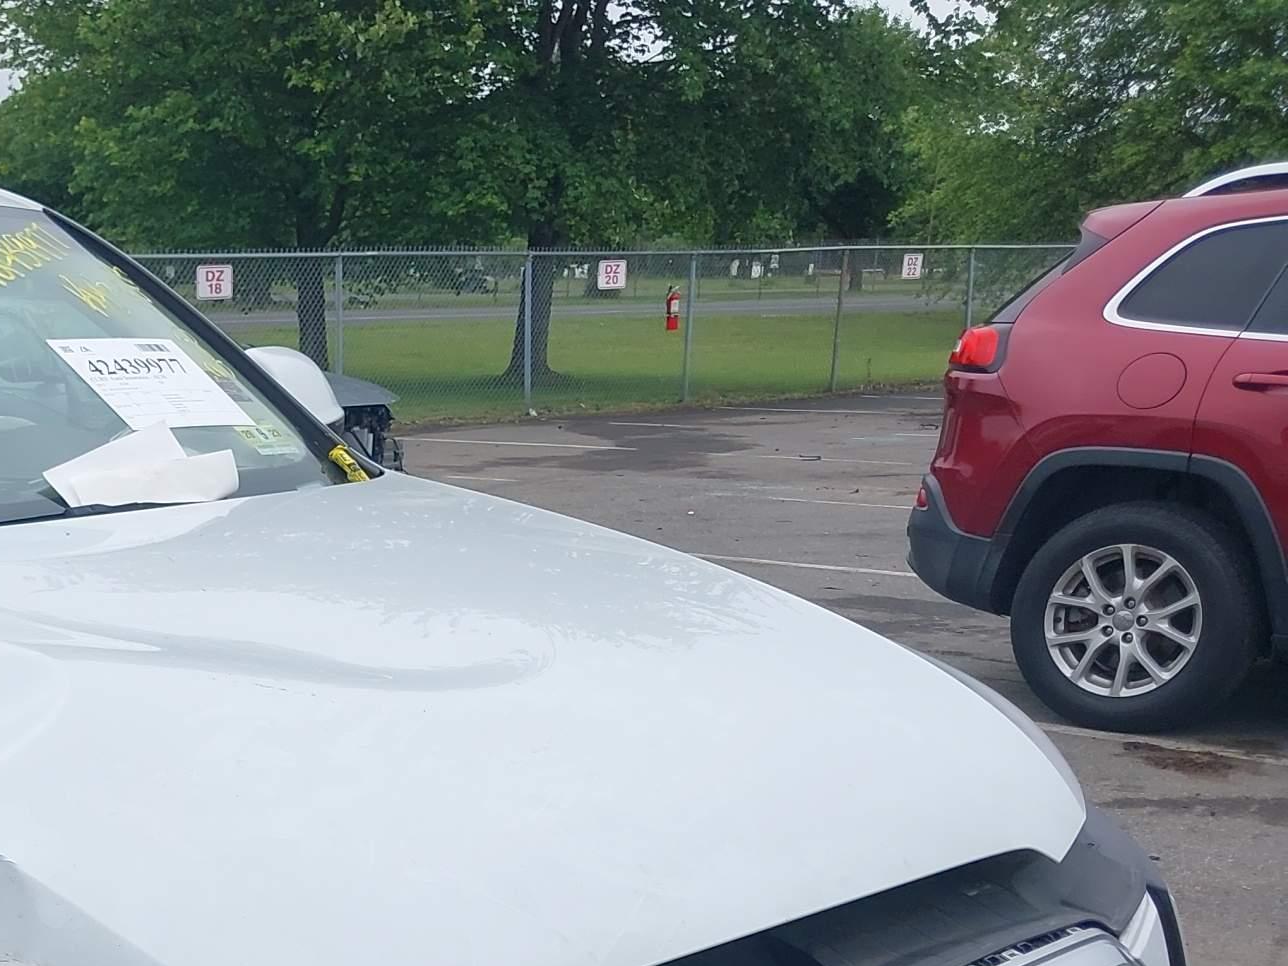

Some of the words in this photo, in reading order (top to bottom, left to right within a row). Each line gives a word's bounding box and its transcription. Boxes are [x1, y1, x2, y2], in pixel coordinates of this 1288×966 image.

[907, 257, 918, 266] DZ
[605, 264, 620, 274] DZ
[907, 267, 917, 275] 22
[206, 270, 224, 281] DZ
[605, 275, 618, 285] 20
[208, 283, 222, 294] 18
[88, 358, 187, 375] 42439977
